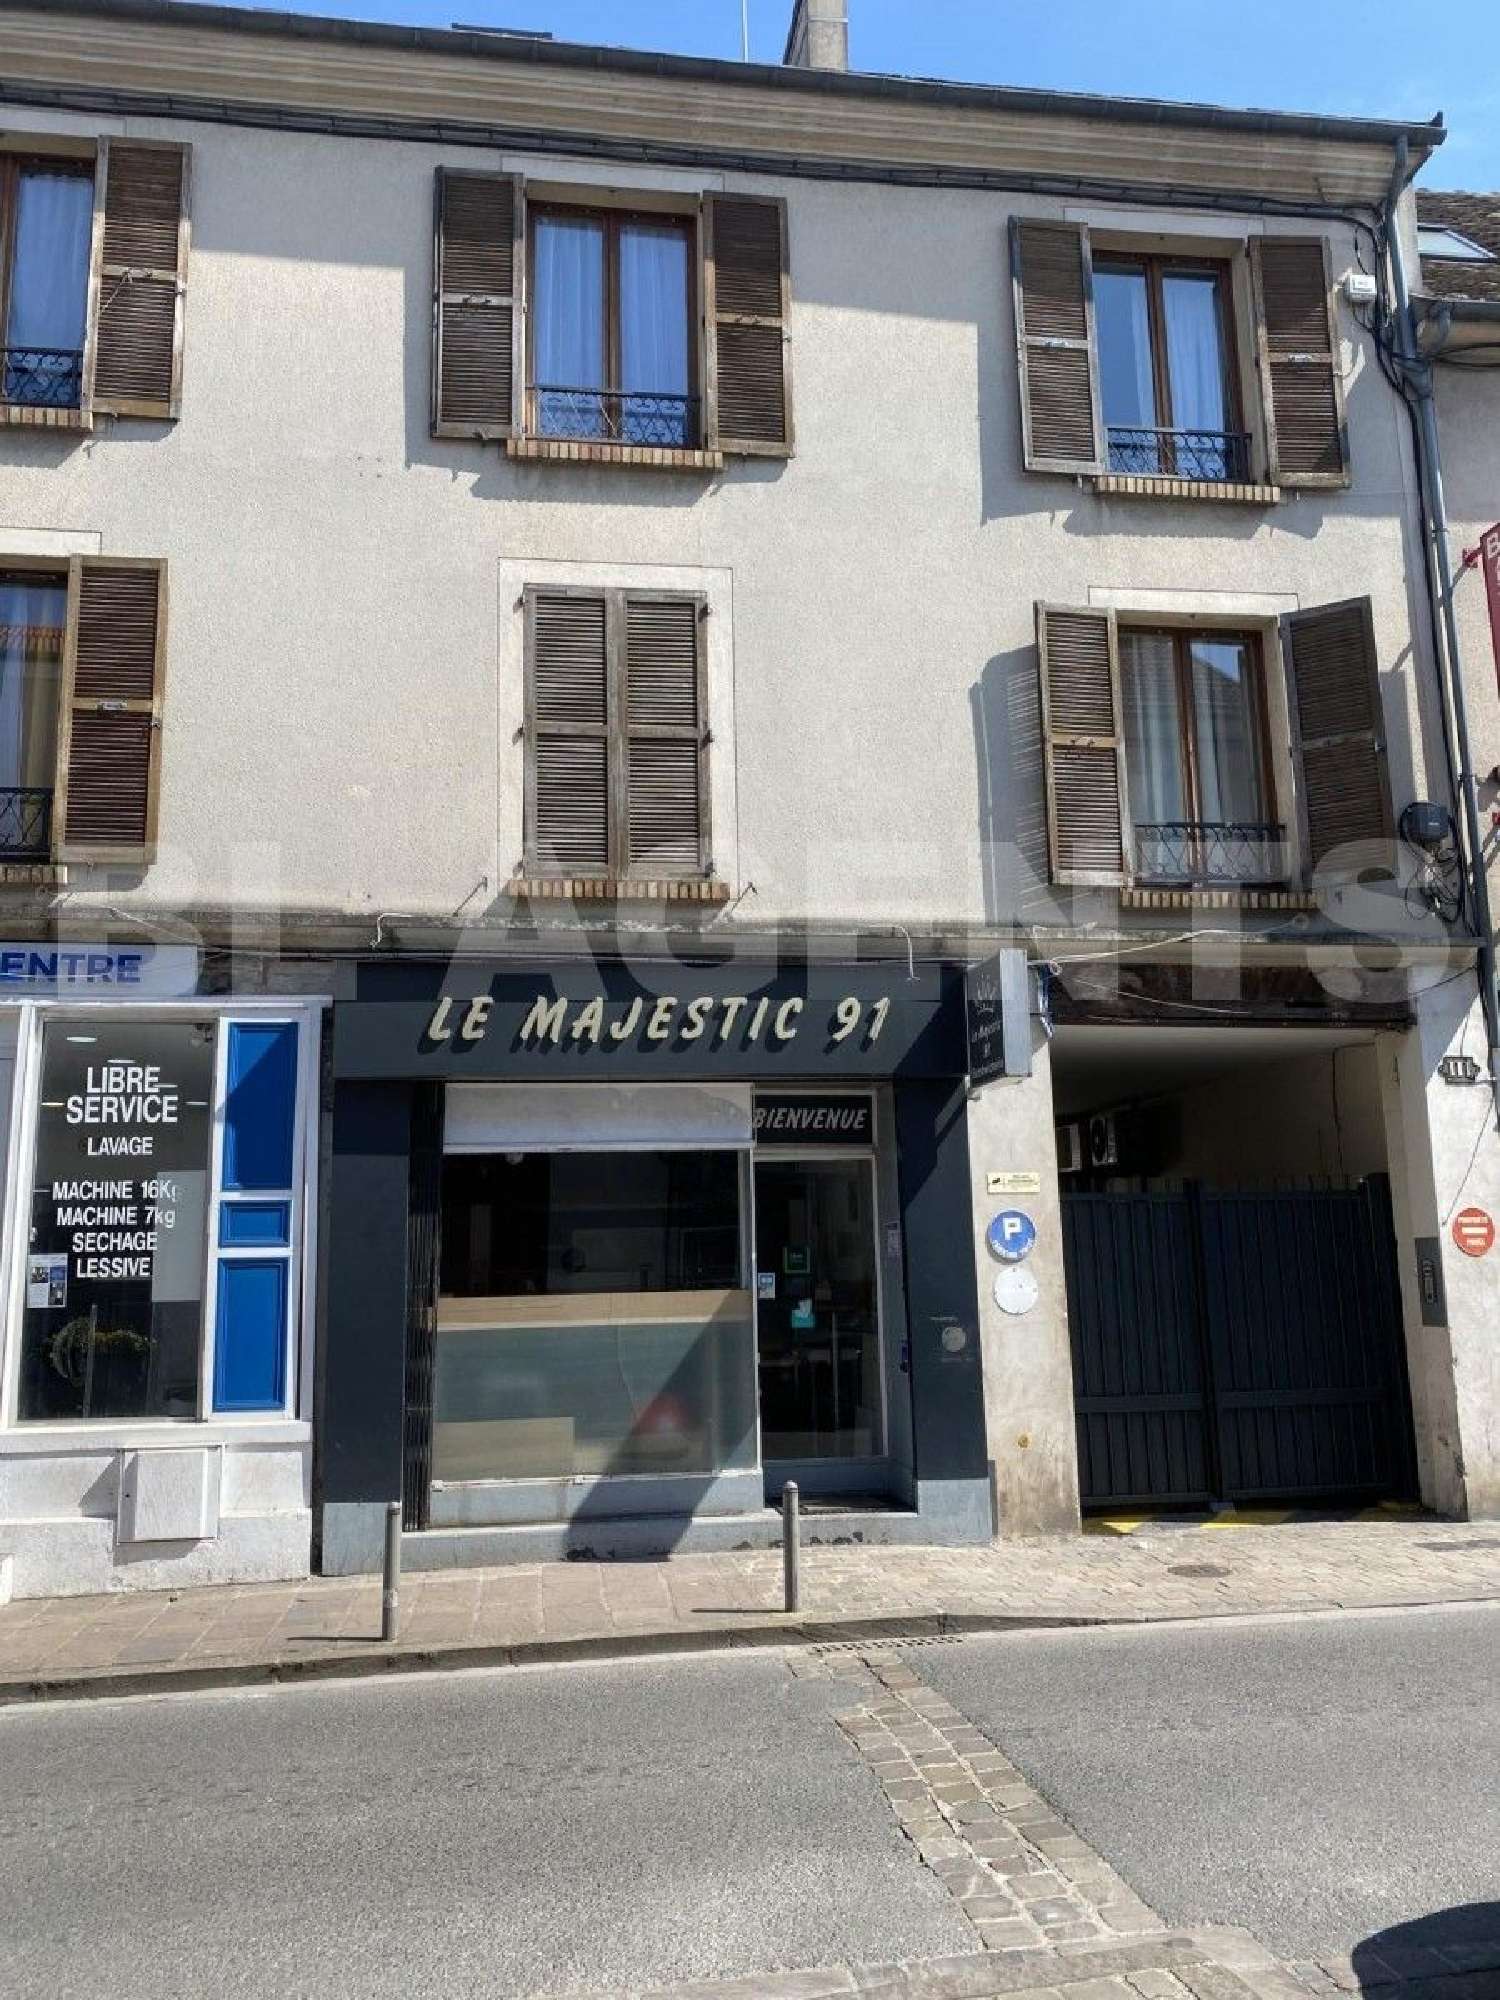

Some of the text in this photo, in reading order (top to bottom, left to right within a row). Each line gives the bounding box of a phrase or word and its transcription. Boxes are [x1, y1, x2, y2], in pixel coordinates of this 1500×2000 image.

[0, 953, 143, 983] ENTRE
[428, 996, 890, 1043] LE MAJESTIC 91
[87, 1066, 160, 1093] LIBRE
[66, 1095, 178, 1123] SERVICE
[752, 1107, 868, 1130] BIENVENUE
[87, 1136, 153, 1156] LAVAGE
[52, 1180, 134, 1200] MACHINE
[56, 1206, 176, 1228] MACHINE 7kg
[1002, 1217, 1023, 1241] P
[72, 1231, 158, 1253] SECHAGE
[76, 1256, 151, 1278] LESSIVE
